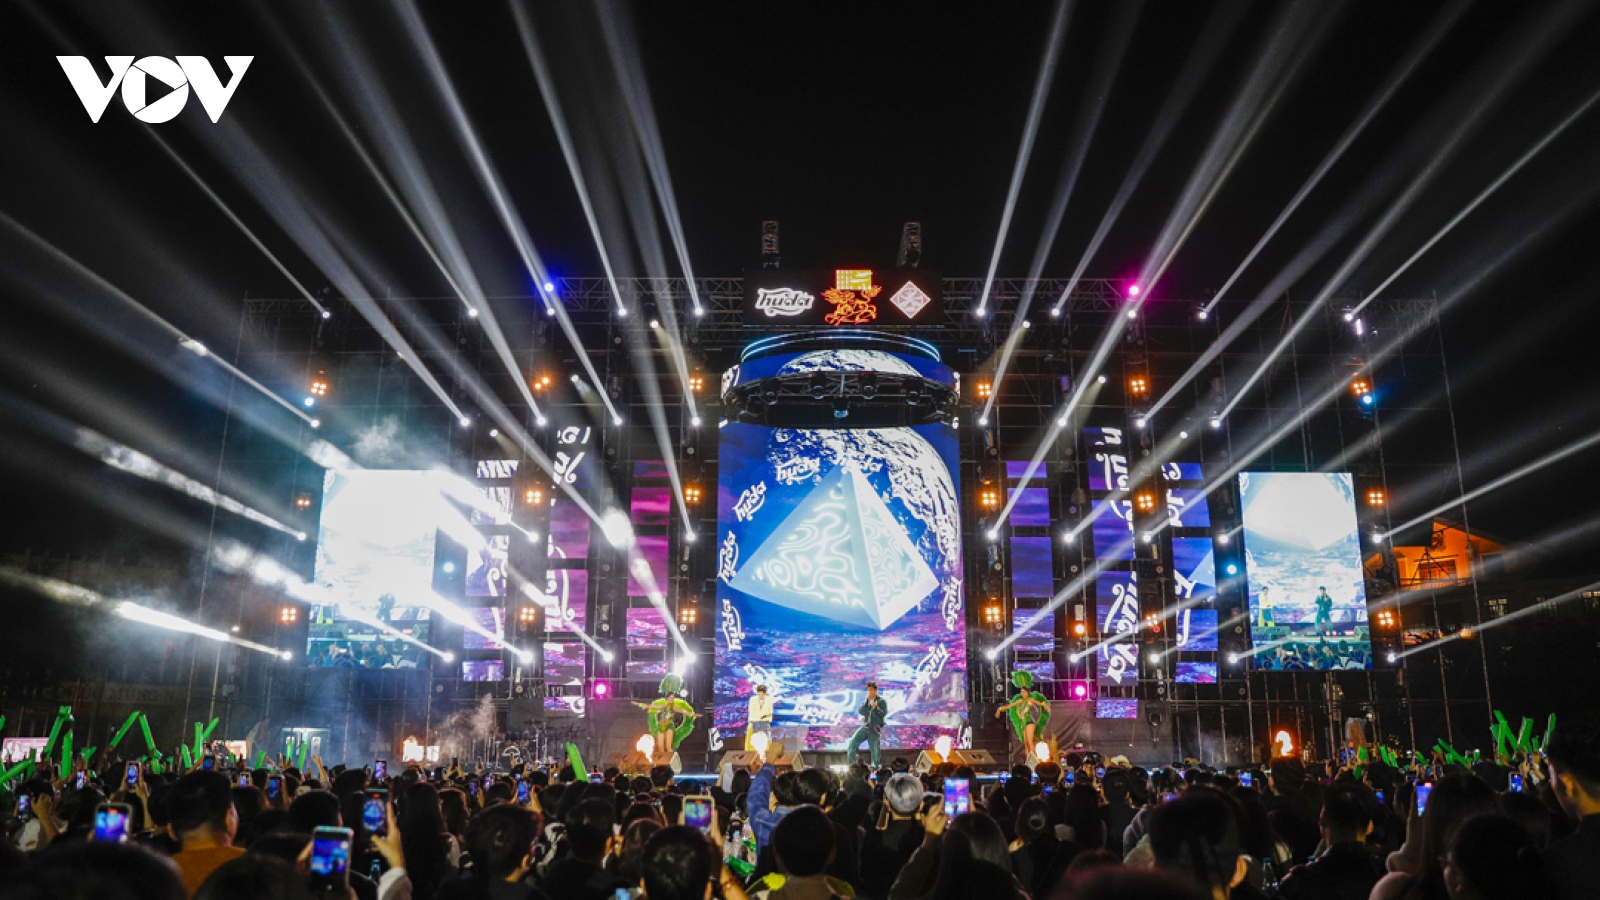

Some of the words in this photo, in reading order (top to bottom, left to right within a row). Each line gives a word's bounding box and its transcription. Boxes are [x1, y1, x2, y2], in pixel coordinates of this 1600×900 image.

[755, 288, 815, 317] huda
[732, 481, 767, 522] huda
[718, 530, 739, 584] huda
[723, 599, 745, 652] huda
[942, 577, 963, 631] huda
